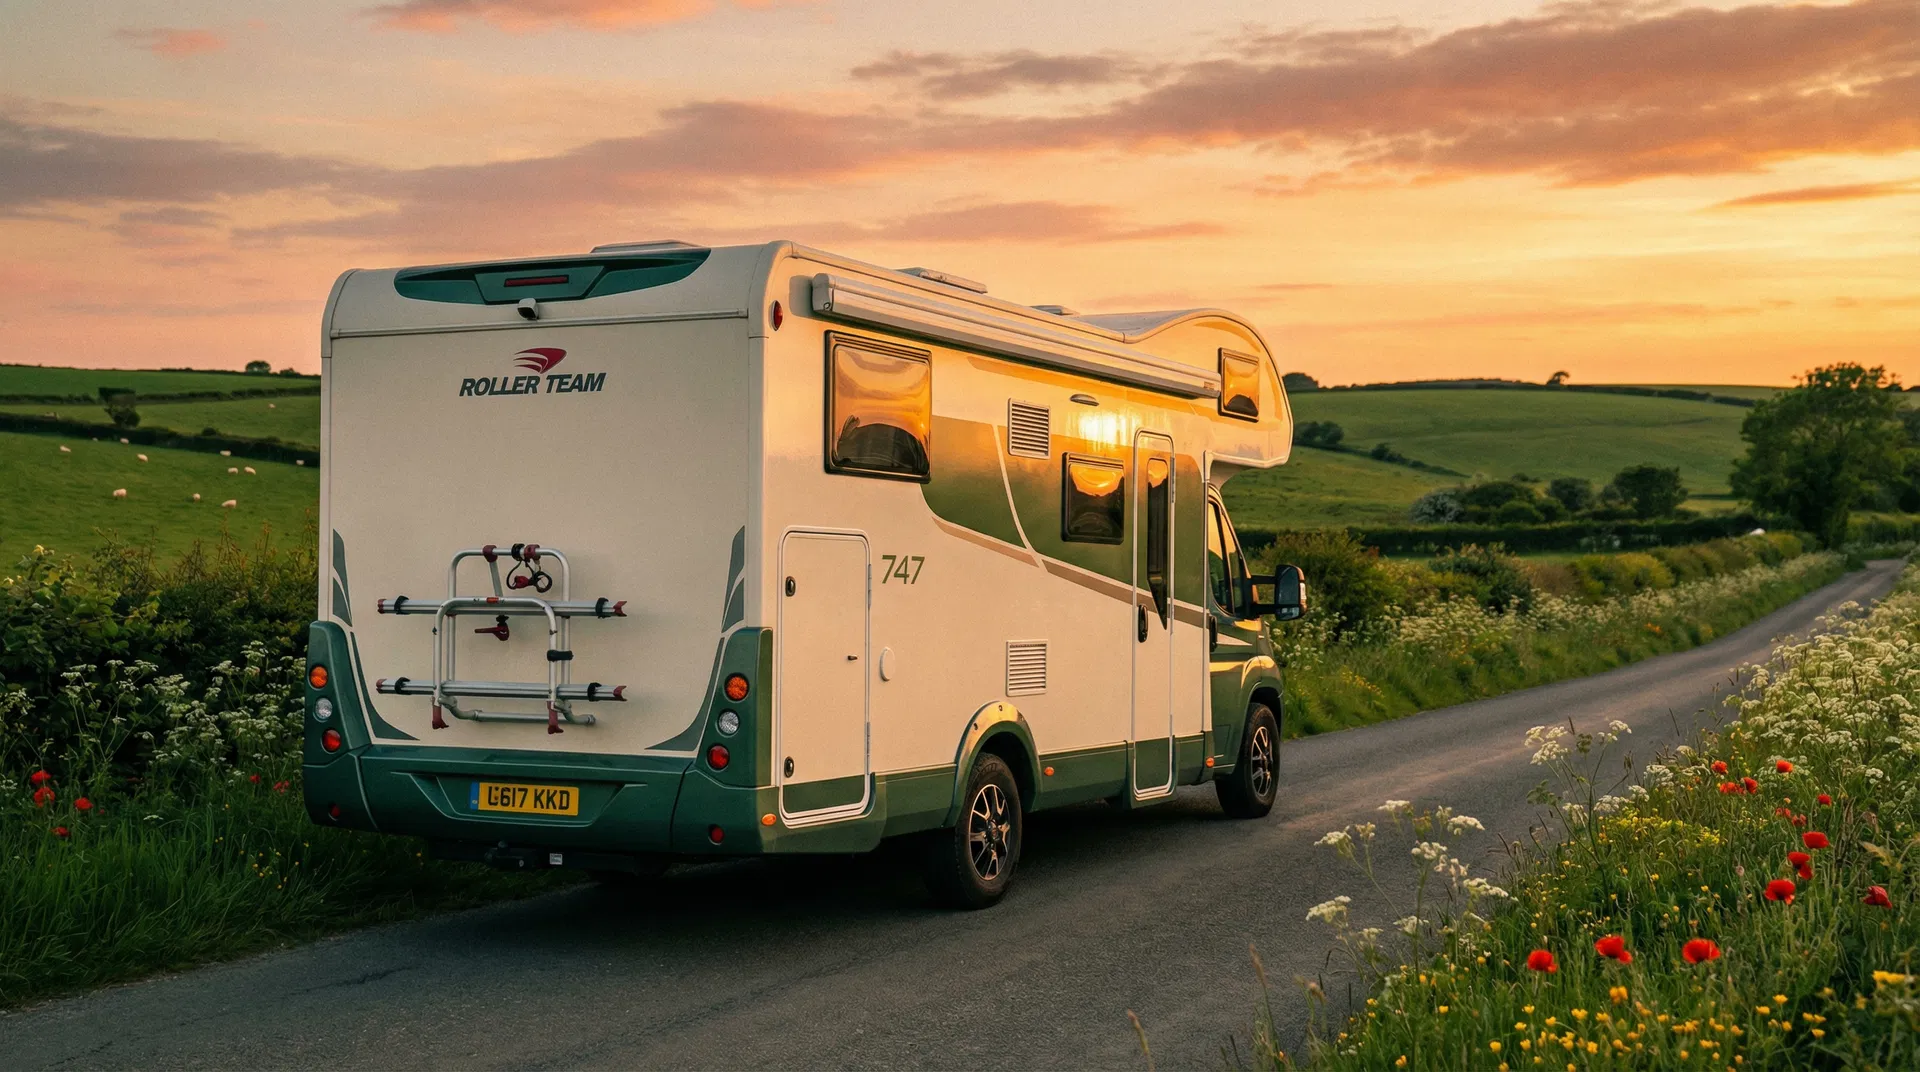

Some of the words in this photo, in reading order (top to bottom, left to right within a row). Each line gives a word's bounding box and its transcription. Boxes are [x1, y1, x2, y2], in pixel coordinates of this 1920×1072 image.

[459, 375, 540, 396] ROLLER
[546, 372, 606, 393] TEAM
[882, 554, 925, 584] 747
[533, 788, 570, 810] KKD
